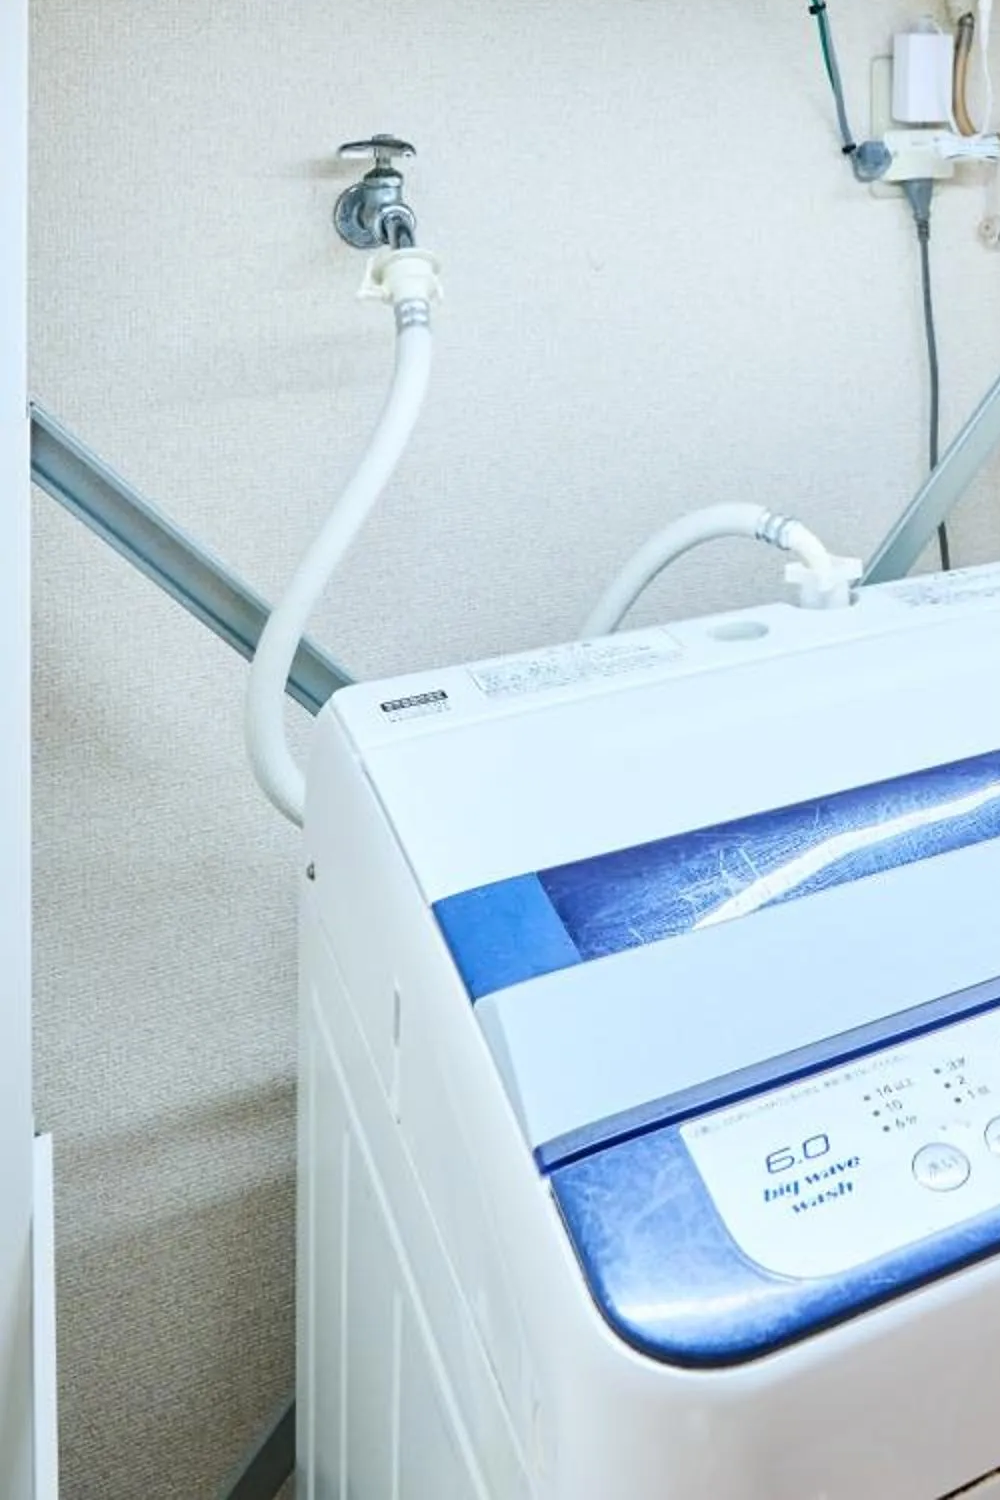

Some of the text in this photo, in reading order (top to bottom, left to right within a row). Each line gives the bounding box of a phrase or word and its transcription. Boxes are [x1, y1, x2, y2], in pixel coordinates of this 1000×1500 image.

[764, 1132, 831, 1175] 6.0
[762, 1154, 861, 1204] big wave
[792, 1179, 854, 1216] wash
